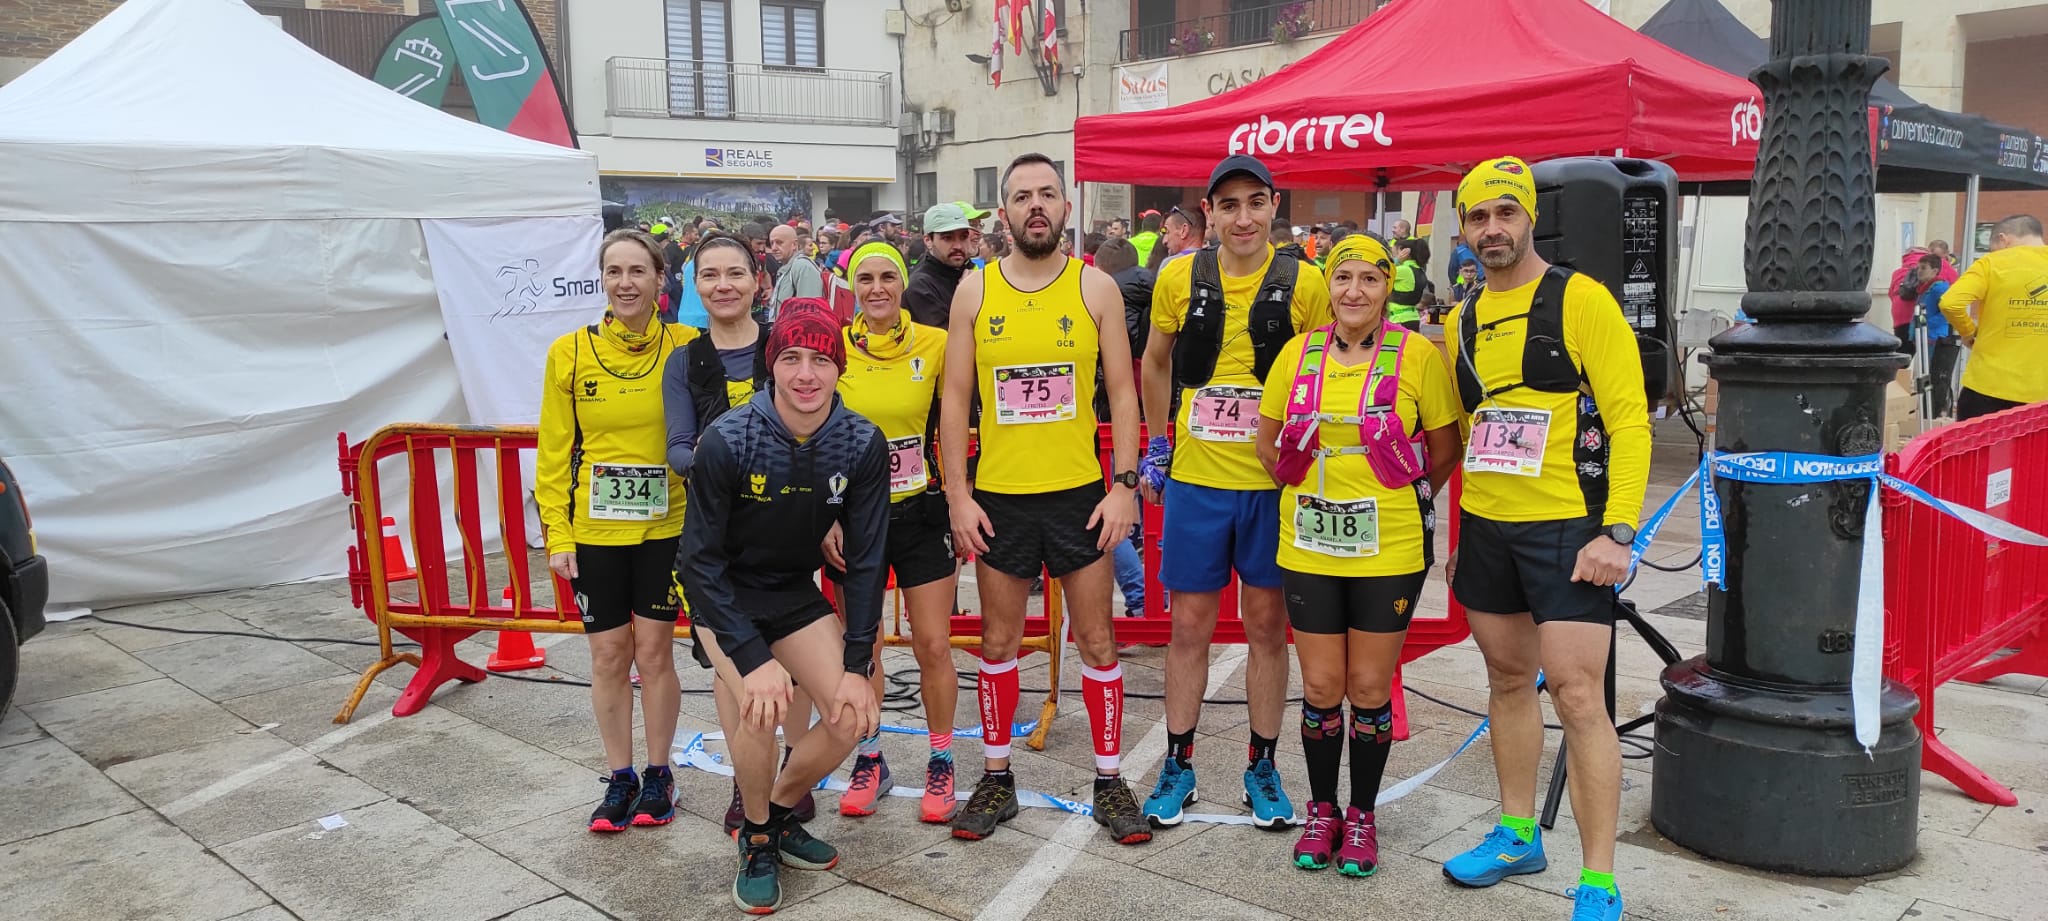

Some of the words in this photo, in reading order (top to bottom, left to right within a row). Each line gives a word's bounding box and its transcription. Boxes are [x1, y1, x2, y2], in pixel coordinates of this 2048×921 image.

[1731, 95, 1765, 147] fib
[726, 149, 773, 160] REALE
[726, 159, 774, 168] SEGUROS
[1056, 340, 1075, 348] GCB
[1021, 379, 1051, 402] 75
[1213, 400, 1241, 422] 74
[609, 478, 651, 500] 334
[1313, 511, 1358, 538] 318
